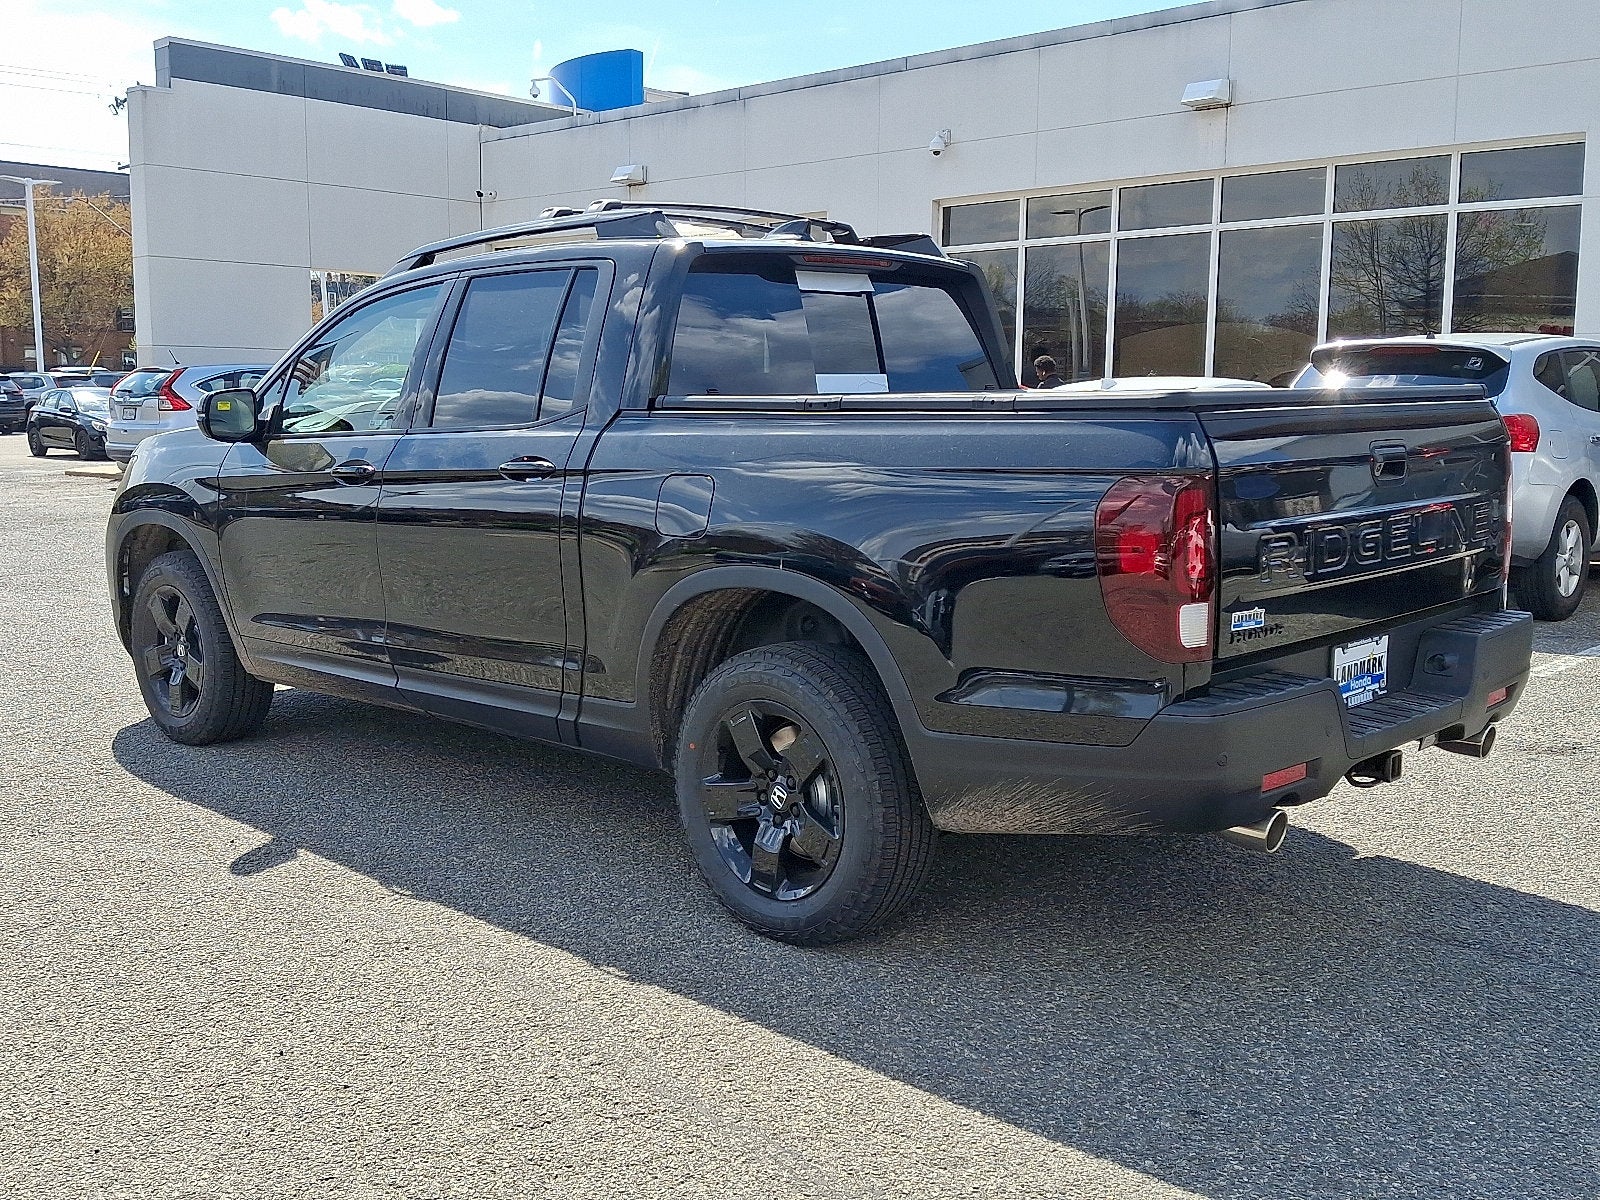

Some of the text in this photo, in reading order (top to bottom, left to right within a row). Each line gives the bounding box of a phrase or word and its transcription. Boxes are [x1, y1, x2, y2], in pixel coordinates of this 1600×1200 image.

[1259, 500, 1490, 583] RIDGELINE
[1336, 654, 1384, 684] LANDMARK
[1350, 675, 1372, 690] Honda
